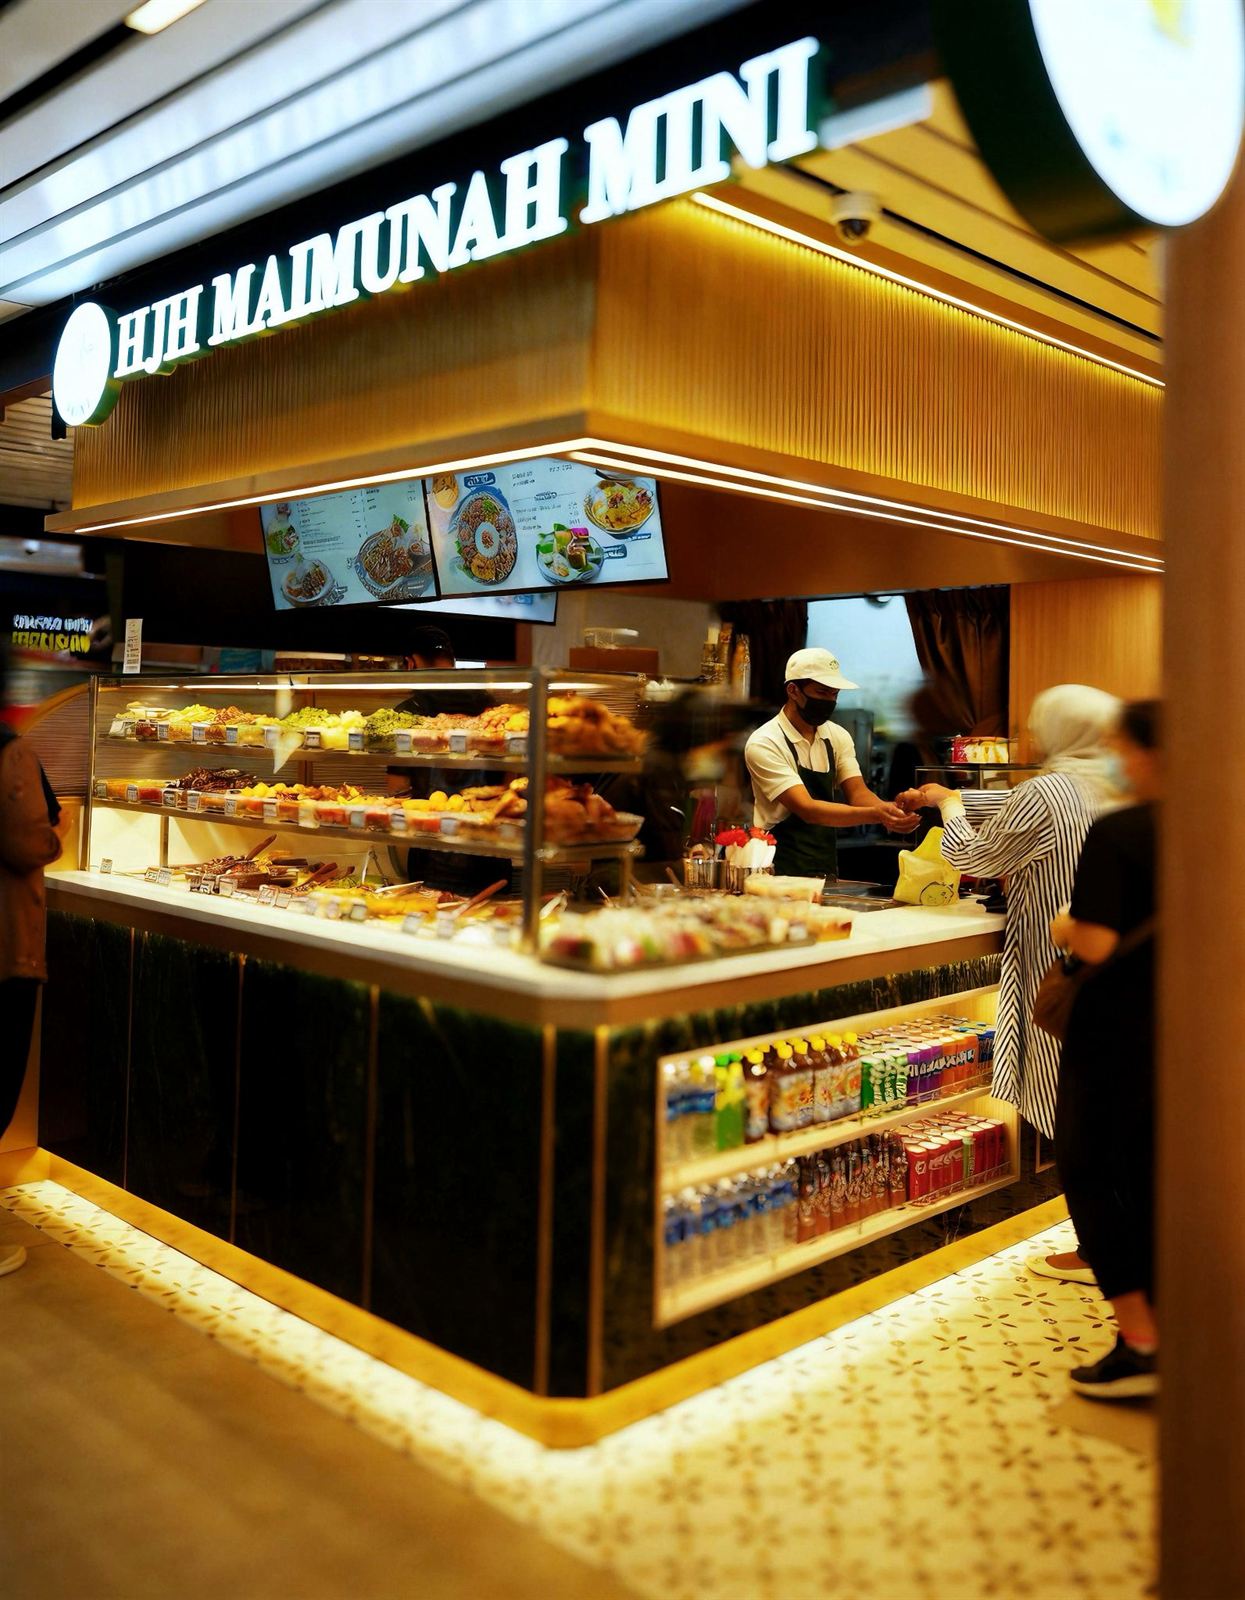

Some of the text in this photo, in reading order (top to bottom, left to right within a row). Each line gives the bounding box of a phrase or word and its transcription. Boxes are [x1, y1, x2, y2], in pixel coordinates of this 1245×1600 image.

[114, 37, 819, 378] HJH MAIMUNAH MINI
